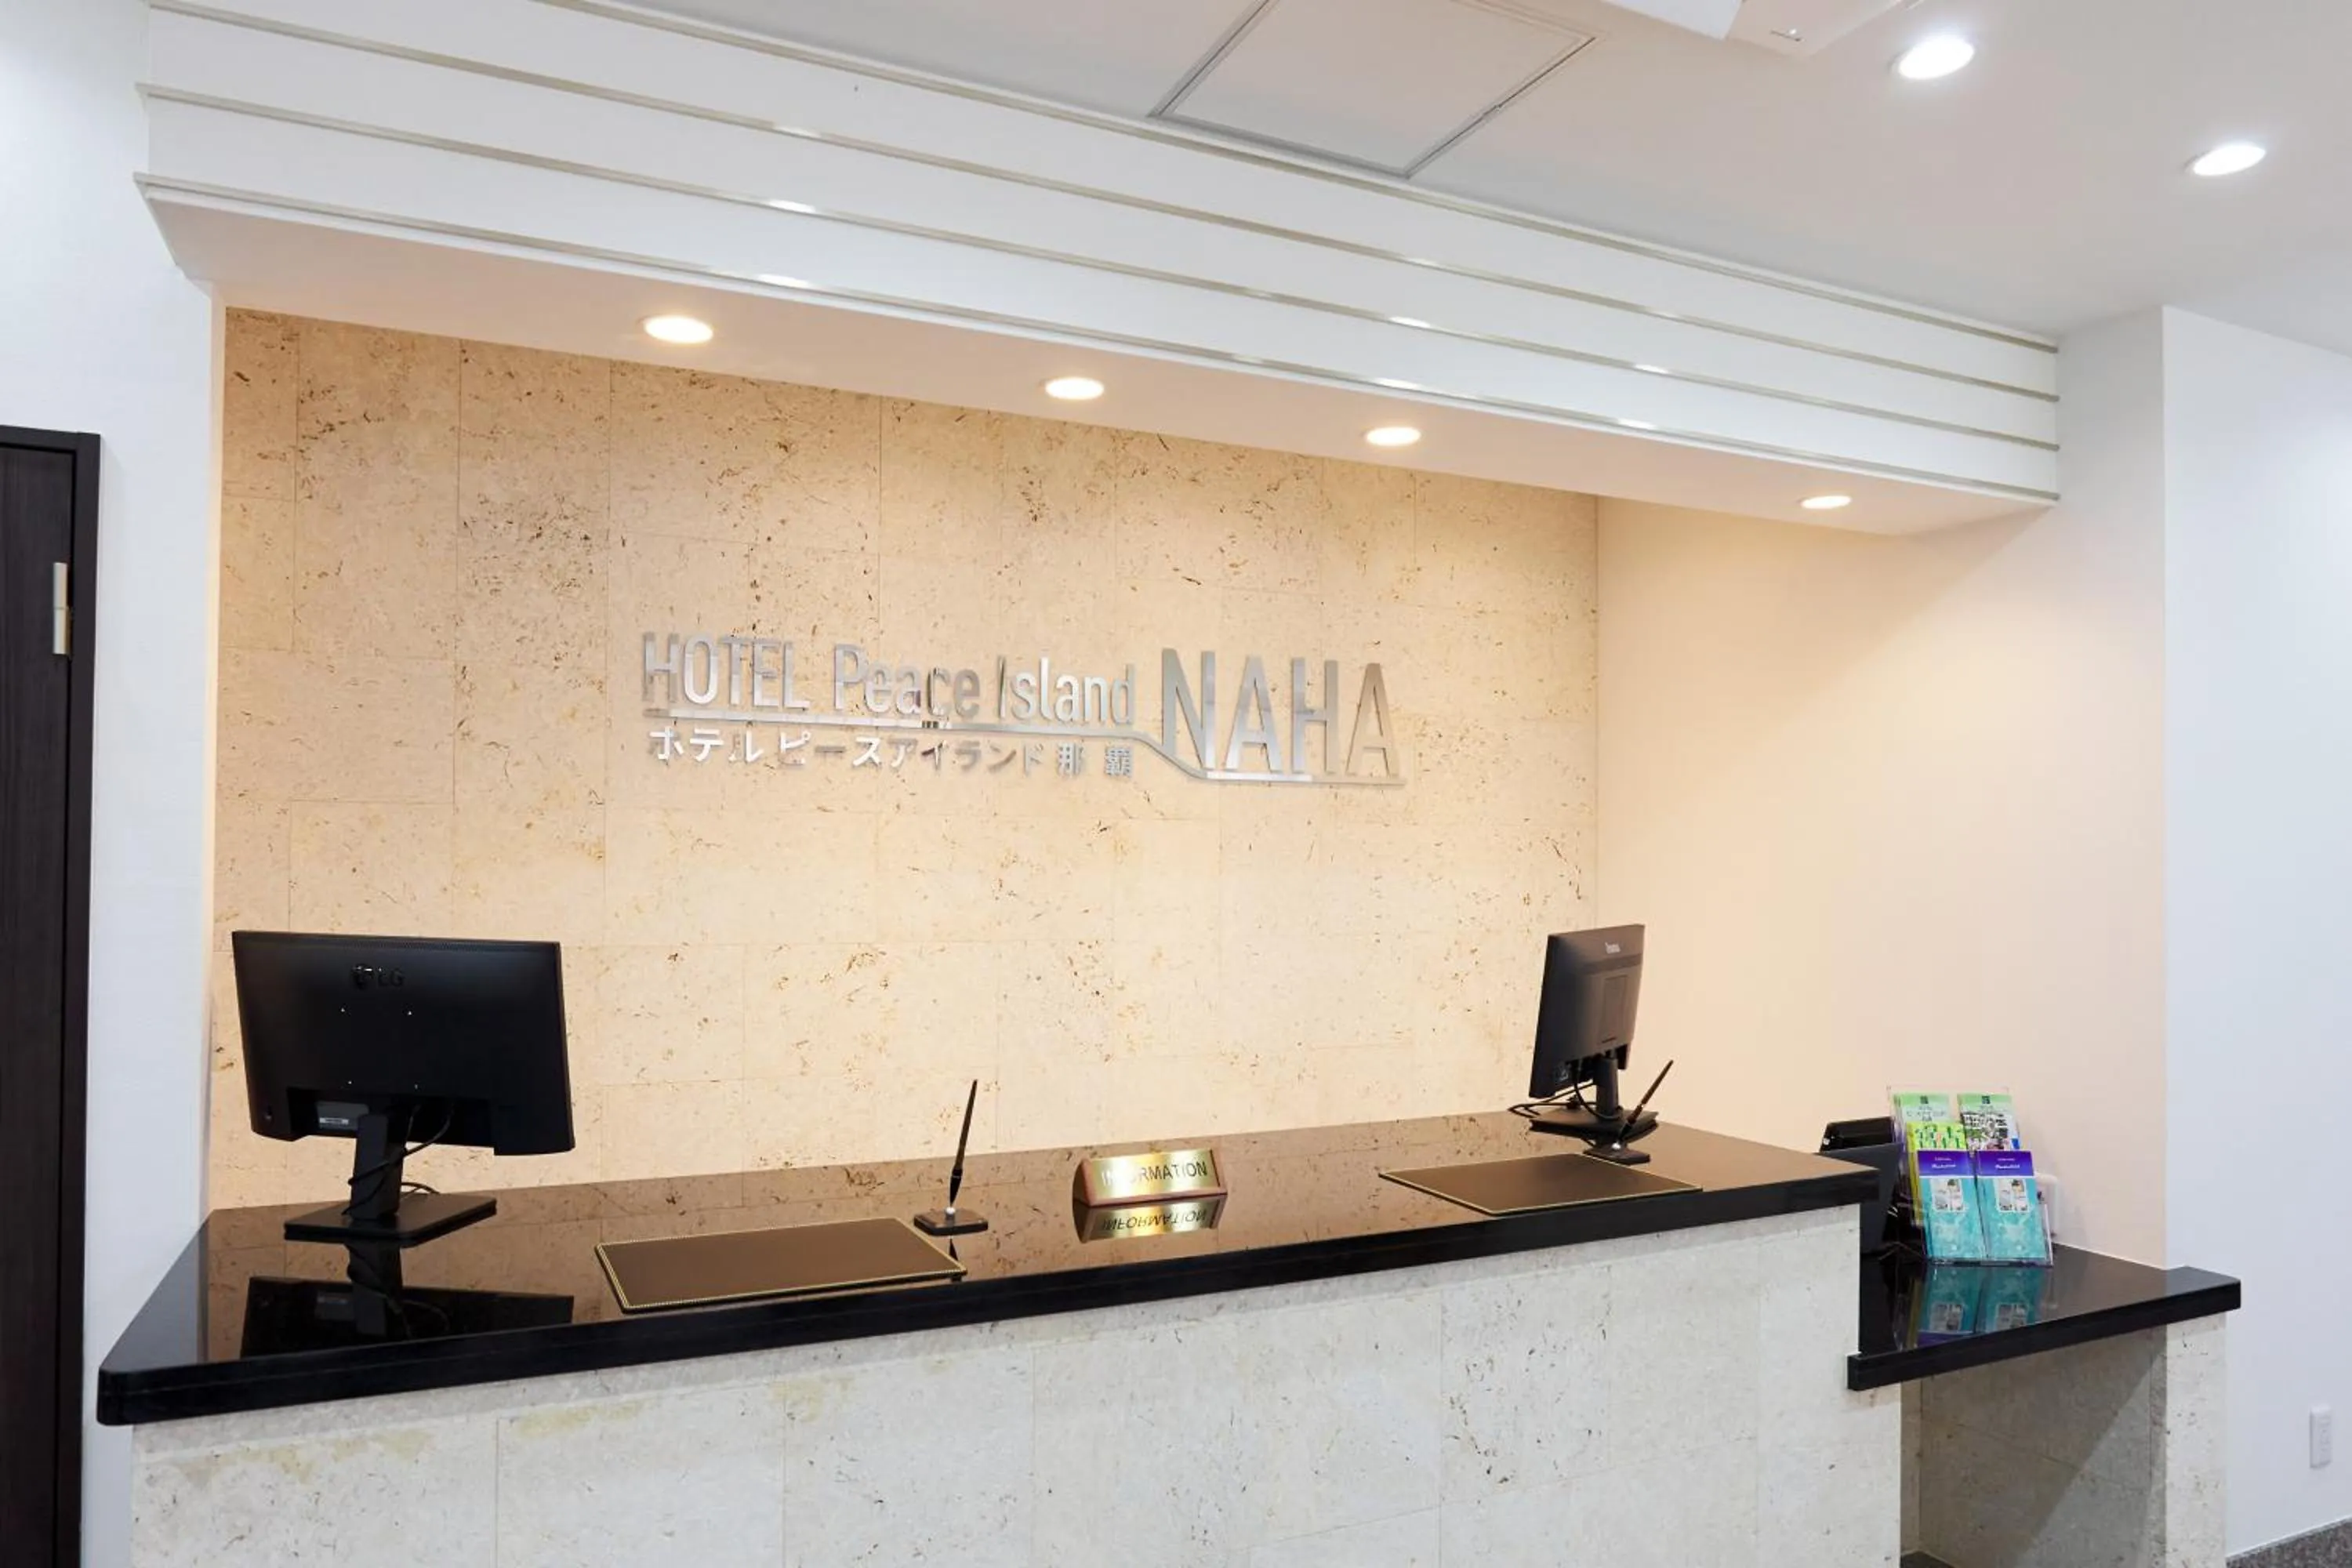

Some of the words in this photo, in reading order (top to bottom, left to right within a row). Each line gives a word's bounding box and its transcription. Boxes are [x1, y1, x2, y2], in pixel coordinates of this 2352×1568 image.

[643, 631, 811, 709] HOTEL
[834, 643, 980, 718] Peace
[996, 655, 1135, 725] Island
[1160, 647, 1400, 778] NAHA
[1102, 1160, 1207, 1185] INRMATION
